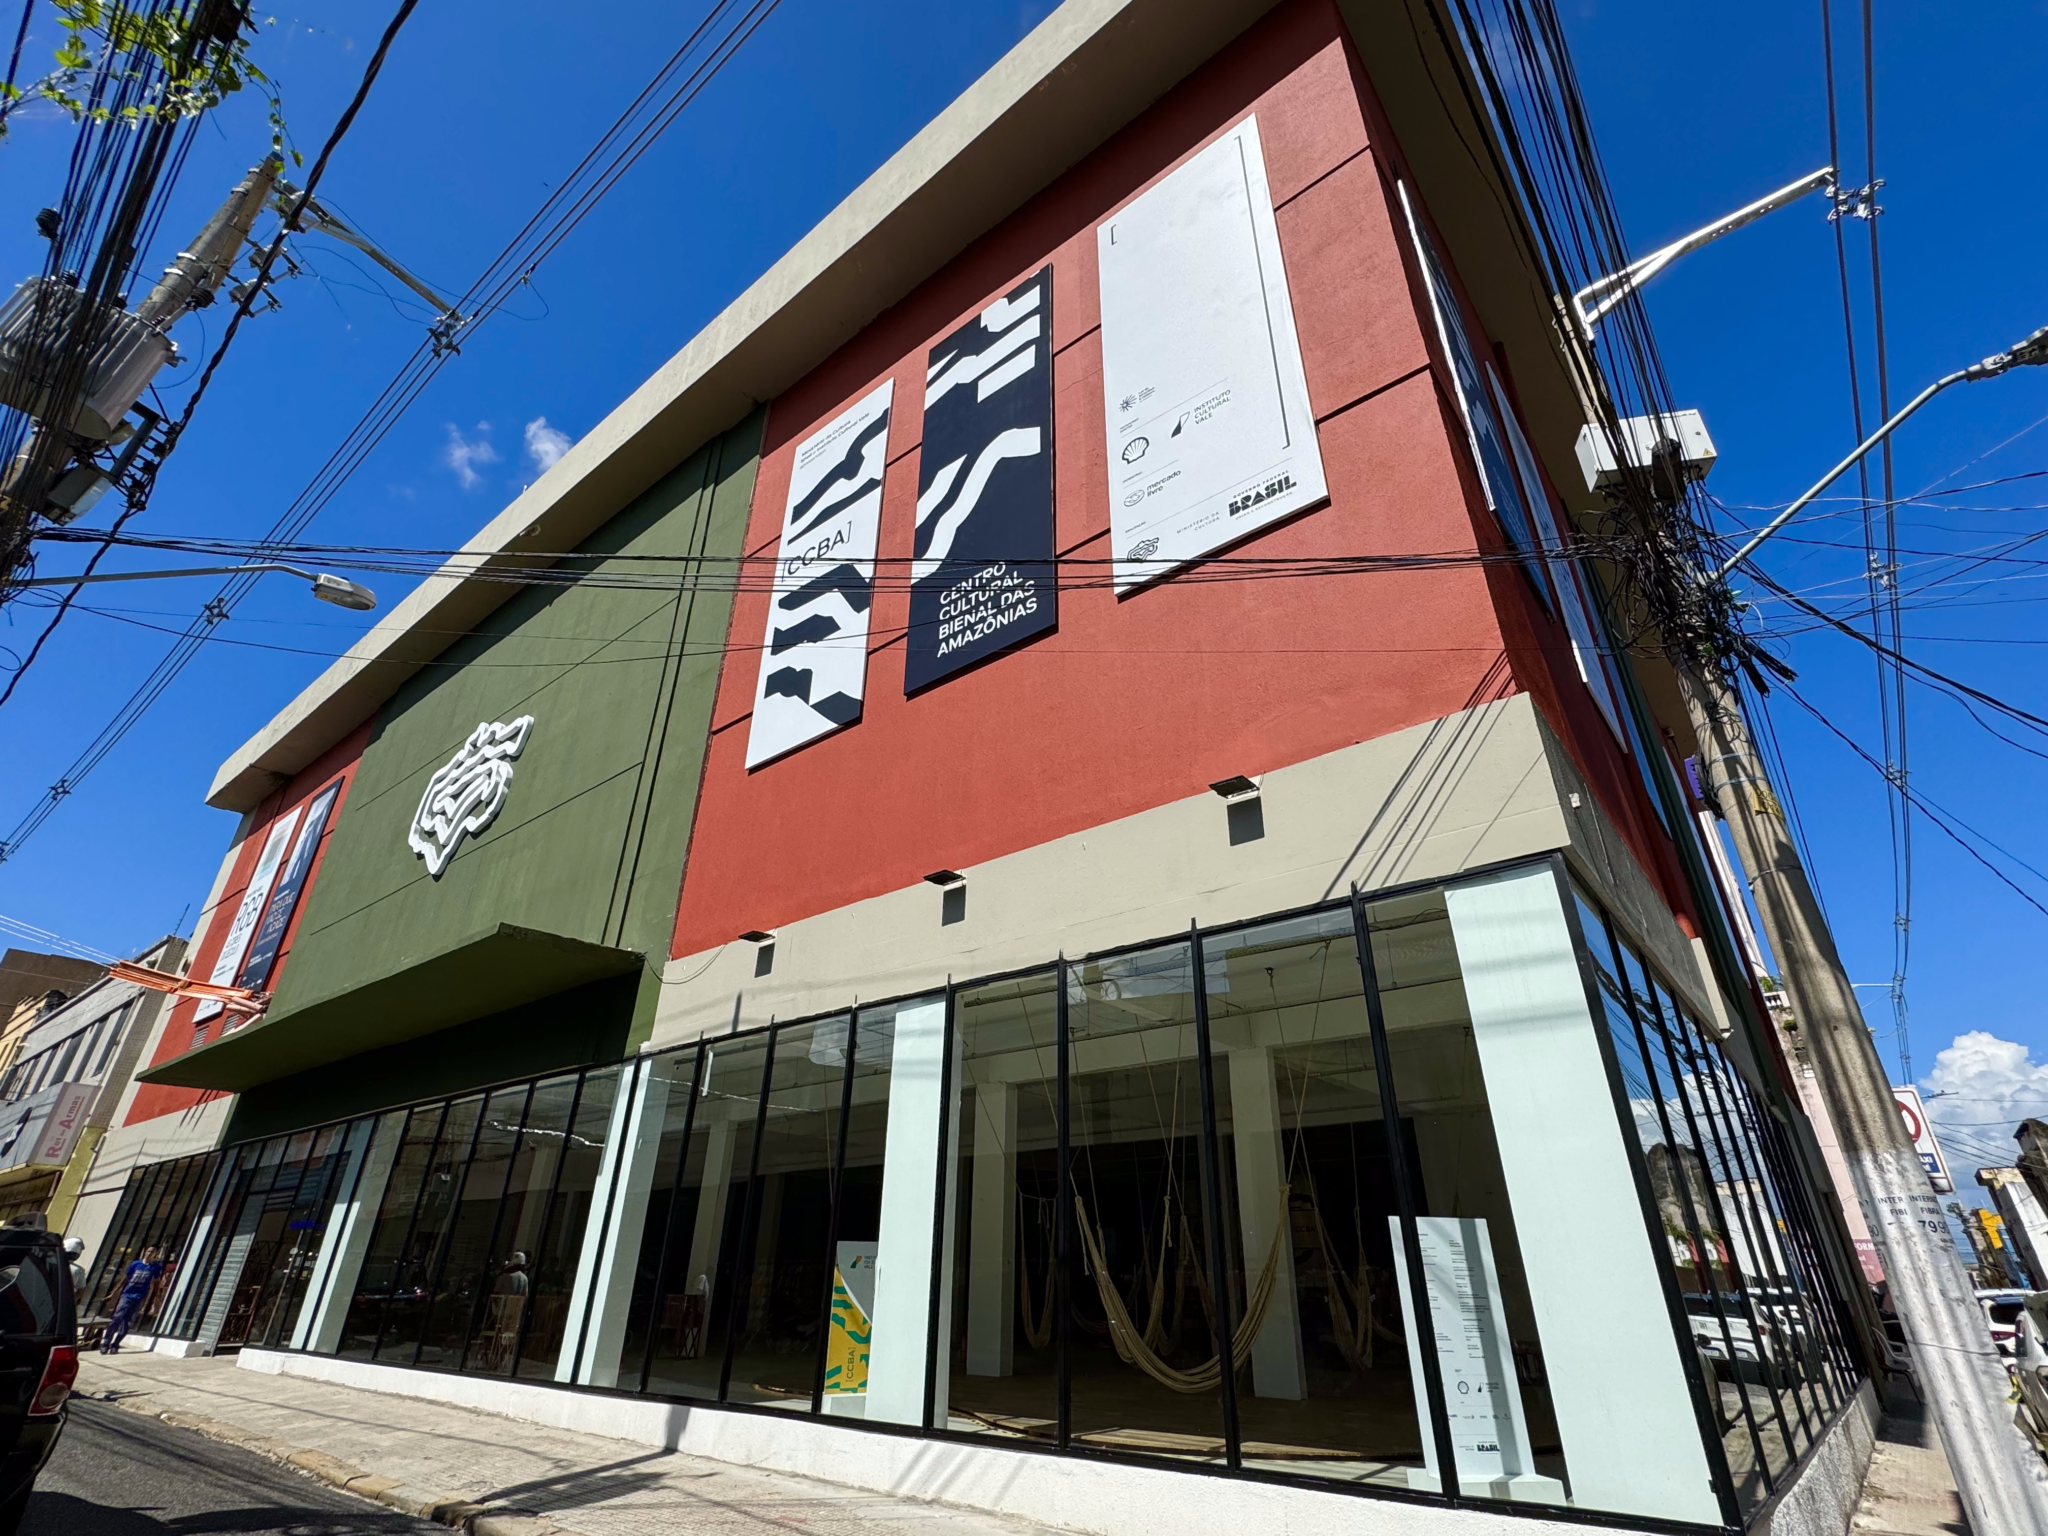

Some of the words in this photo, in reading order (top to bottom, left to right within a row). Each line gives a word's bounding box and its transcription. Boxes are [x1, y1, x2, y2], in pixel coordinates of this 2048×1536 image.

[1193, 389, 1231, 413] INSTITUTO
[1194, 396, 1231, 419] CULTURAL
[1194, 412, 1213, 425] VALE
[1146, 470, 1181, 491] mercado
[1147, 485, 1164, 497] livre
[1233, 483, 1261, 499] GOVERNO
[1262, 469, 1289, 485] FEDERAL
[1228, 475, 1297, 517] BRASIL
[1176, 515, 1210, 534] MINISTÉRIO
[1194, 516, 1220, 531] CULTURA
[939, 570, 1024, 620] CULTURAL
[940, 561, 1006, 605] CENTRO
[938, 601, 997, 640] BIENAL
[1000, 580, 1035, 608] DAS
[937, 597, 1037, 658] AMAZÔNIAS
[59, 1096, 82, 1130] Armas
[845, 1347, 856, 1383] [CCBA]
[1476, 1444, 1500, 1452] BRASIL
